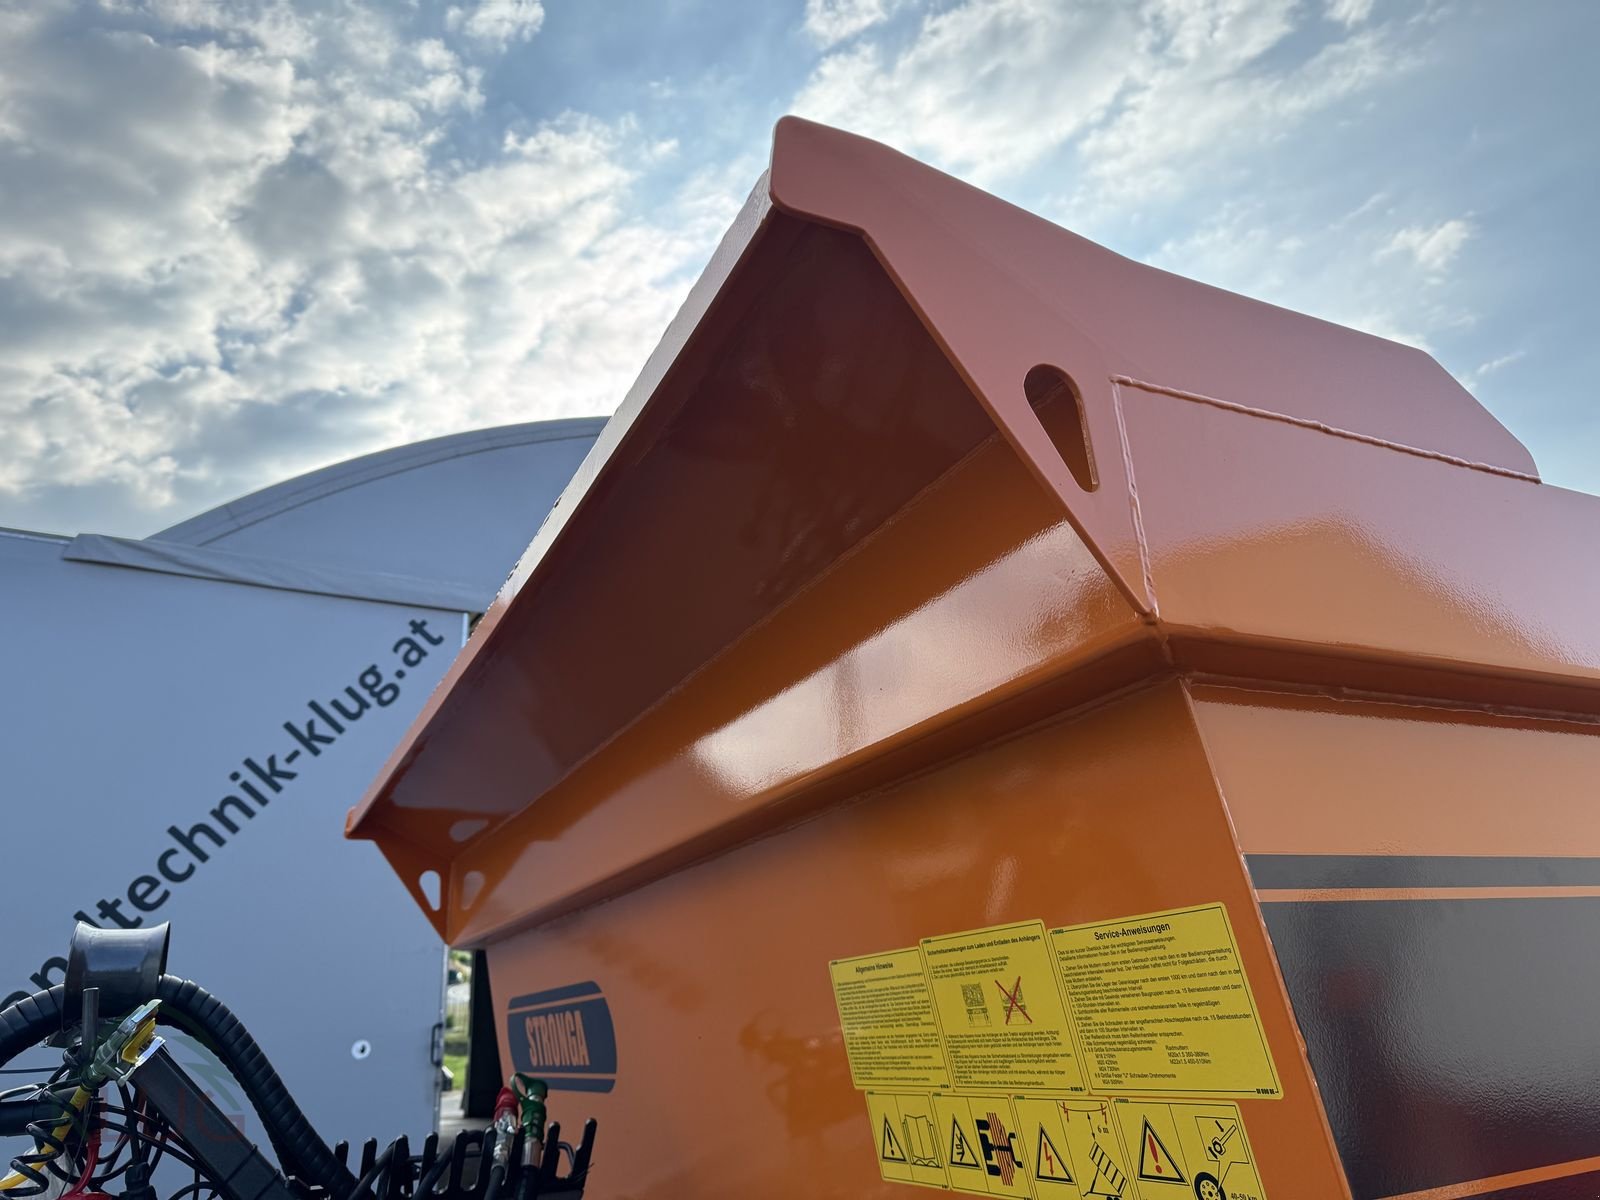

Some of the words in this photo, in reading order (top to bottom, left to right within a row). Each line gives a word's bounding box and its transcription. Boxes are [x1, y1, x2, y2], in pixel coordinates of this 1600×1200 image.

[0, 618, 444, 1008] ntechnik-klug.at
[1094, 922, 1170, 941] Service-Anweisungen
[875, 961, 893, 970] Hinweise
[525, 1009, 590, 1067] STRONGA
